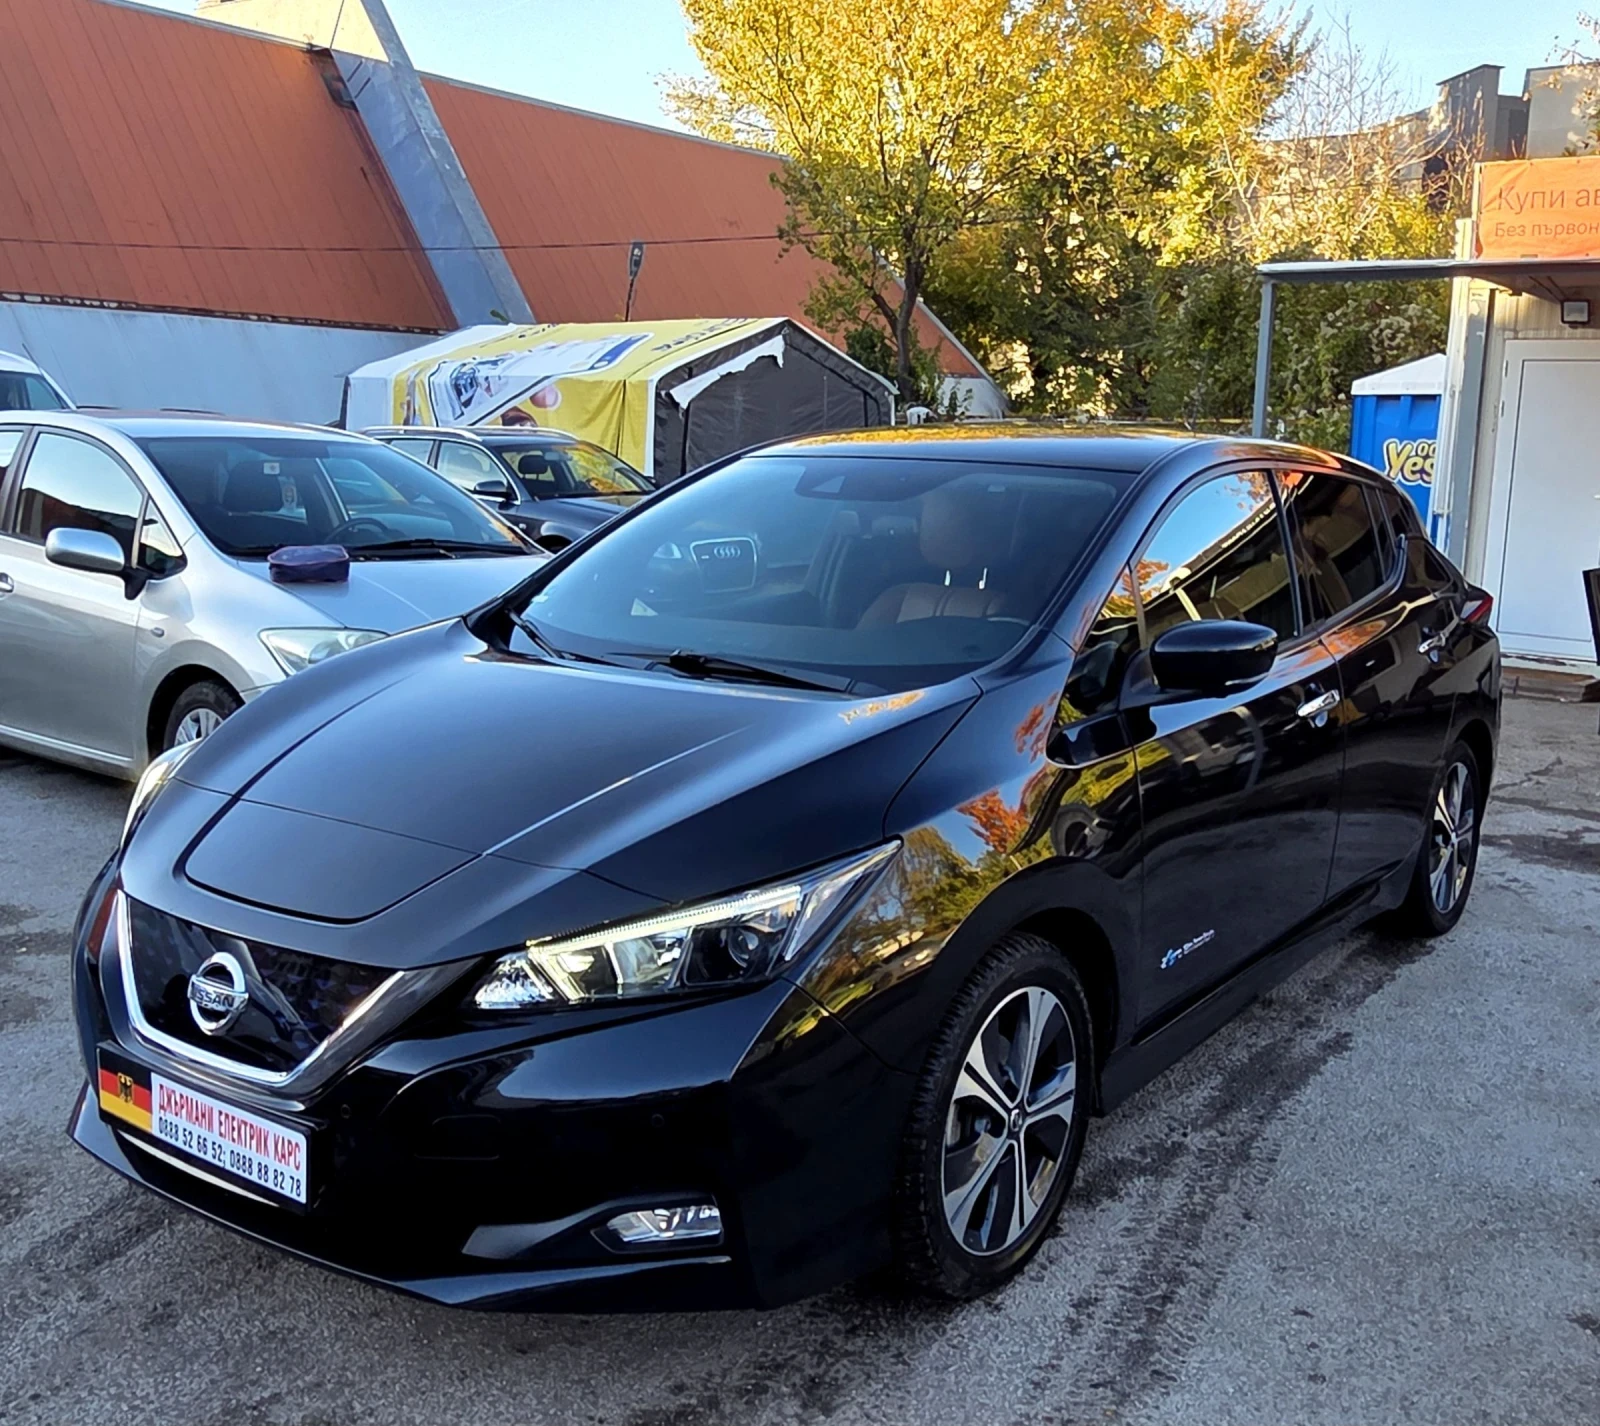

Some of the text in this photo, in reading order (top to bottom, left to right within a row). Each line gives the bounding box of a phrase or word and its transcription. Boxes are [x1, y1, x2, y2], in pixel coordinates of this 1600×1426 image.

[1498, 186, 1565, 215] Купи
[1494, 221, 1527, 237] Без
[159, 1084, 301, 1171] ДЖЪРМАНИ ЕЛЕКТРИК КАРС
[159, 1116, 179, 1142] 0888
[182, 1127, 193, 1149] 52
[230, 1149, 253, 1176] 0888
[257, 1161, 269, 1183] 88
[273, 1168, 285, 1190] 82
[289, 1175, 302, 1197] 78
